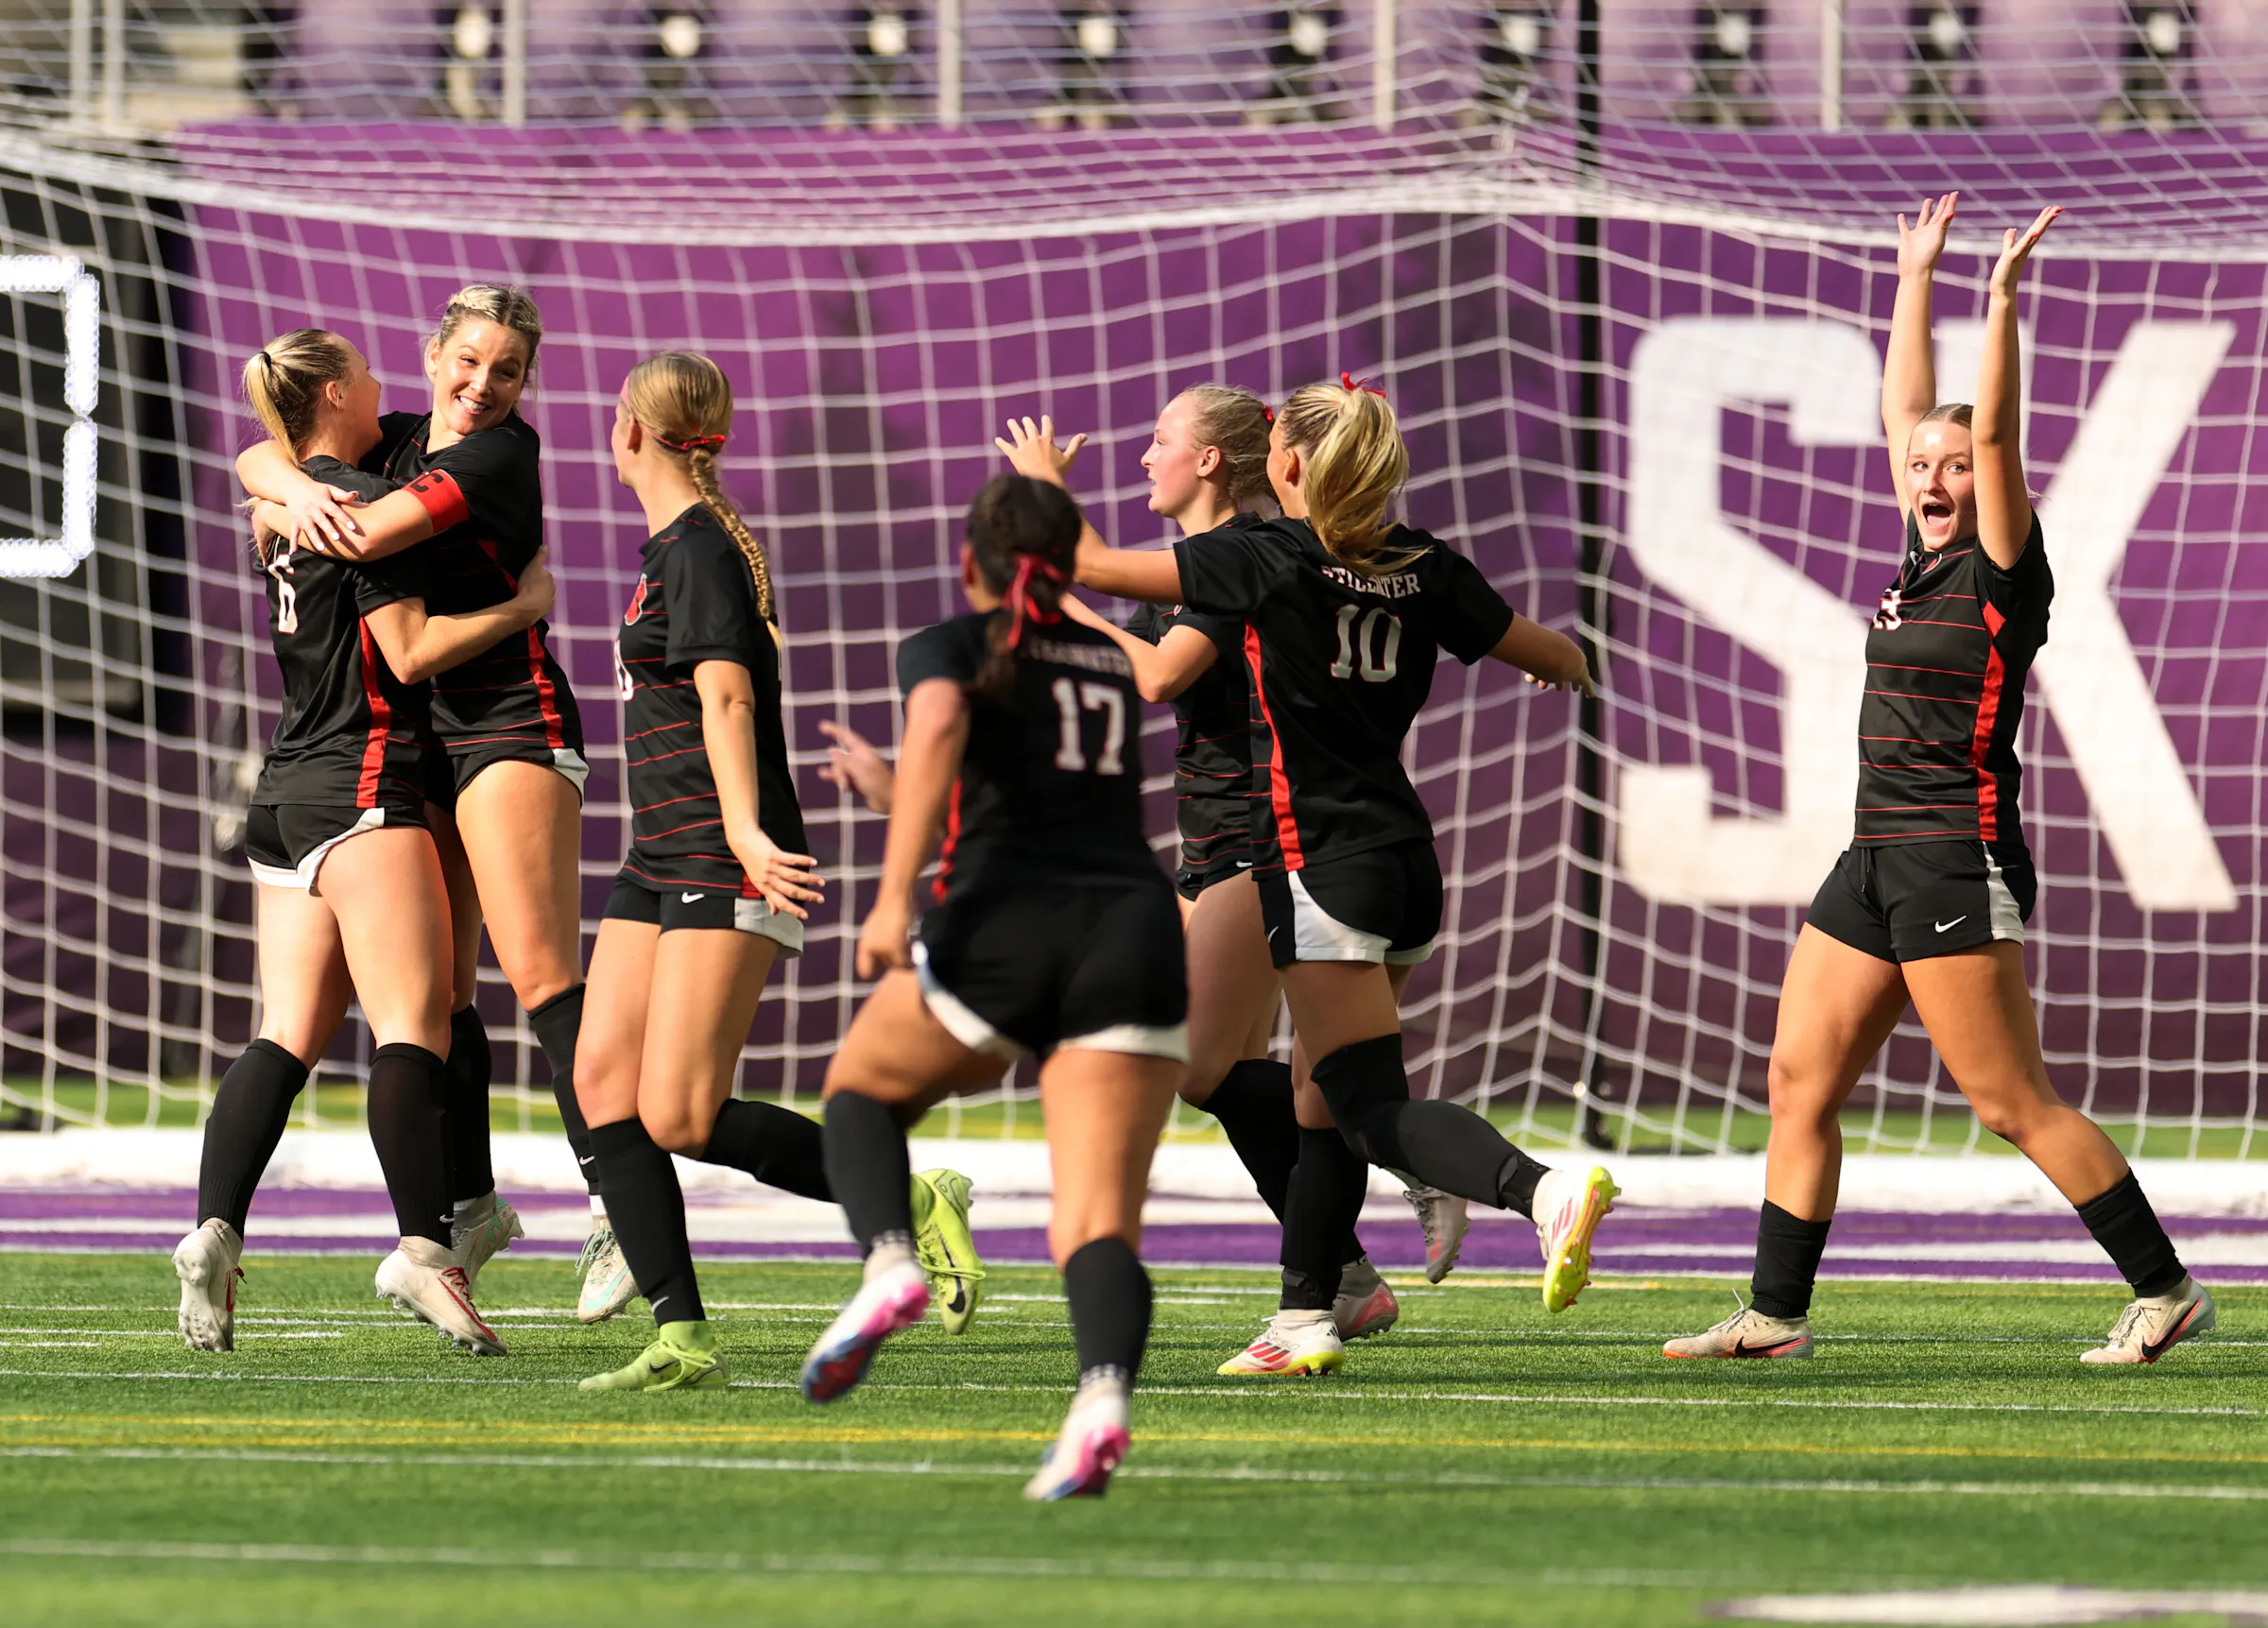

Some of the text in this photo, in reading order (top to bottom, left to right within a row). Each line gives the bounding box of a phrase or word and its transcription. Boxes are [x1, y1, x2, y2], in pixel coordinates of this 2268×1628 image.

[267, 554, 298, 635] 6
[1331, 604, 1402, 682] 10
[1052, 677, 1125, 775] 17
